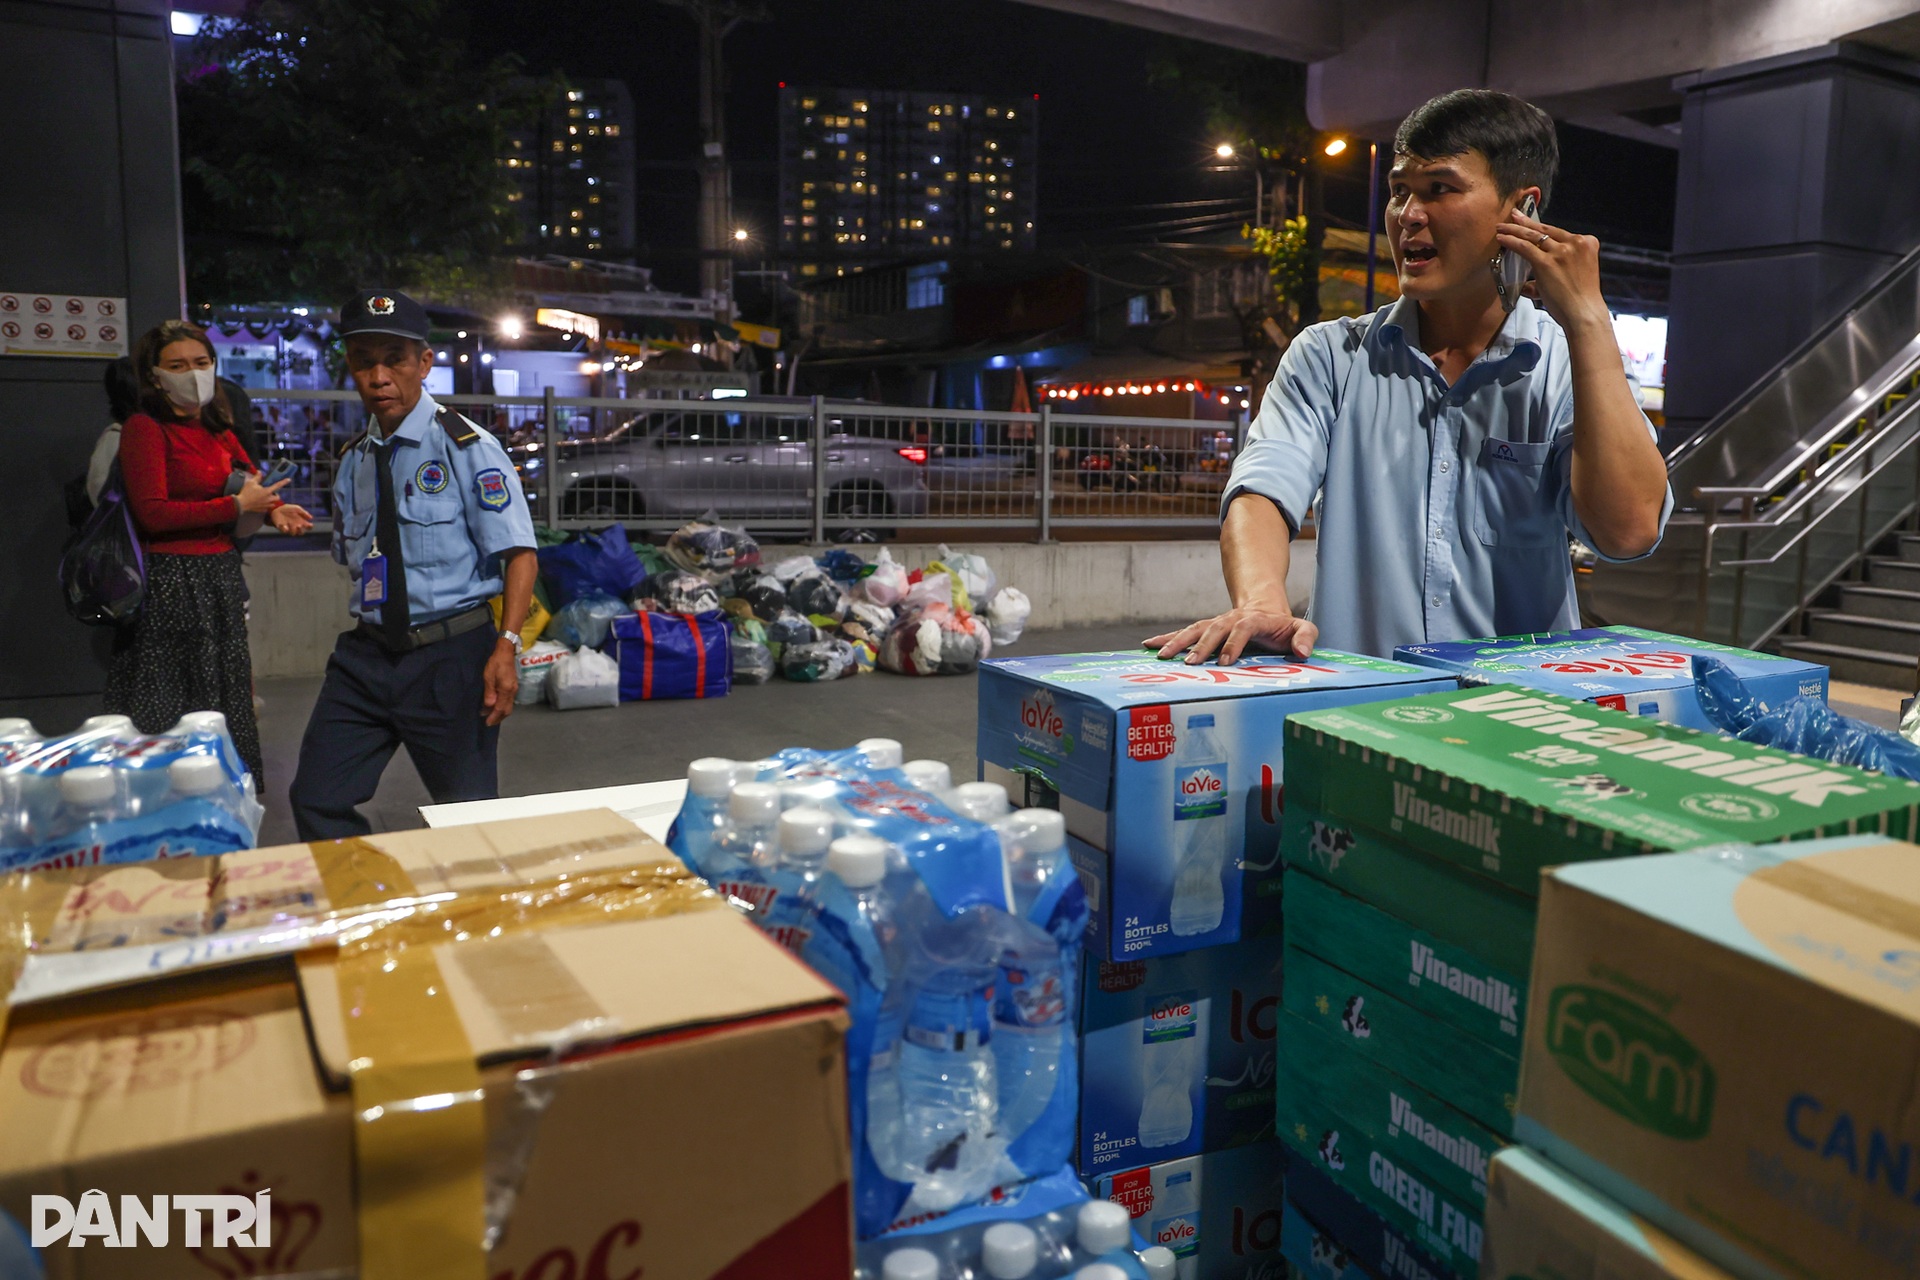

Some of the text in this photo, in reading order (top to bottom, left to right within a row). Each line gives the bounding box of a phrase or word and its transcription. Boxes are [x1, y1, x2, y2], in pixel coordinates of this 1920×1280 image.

[1021, 700, 1064, 738] laVie
[1142, 714, 1158, 723] FOR
[1128, 724, 1174, 741] BETTER
[1128, 741, 1174, 758] HEALTH
[1449, 691, 1867, 807] Vinamilk
[1182, 775, 1221, 794] laVie
[1393, 781, 1501, 856] Vinamilk
[1125, 916, 1139, 928] 24
[1125, 923, 1168, 939] BOTTLES
[1099, 974, 1145, 989] HEALTH
[1411, 940, 1517, 1022] Vinamilk
[1151, 1003, 1190, 1021] laVie
[1093, 1131, 1107, 1142] 24
[1093, 1137, 1137, 1152] BOTTLES
[1390, 1092, 1488, 1183] Vinamilk
[1785, 1093, 1919, 1203] CAN
[1123, 1180, 1138, 1189] FOR
[1369, 1151, 1435, 1228] GREEN
[1157, 1224, 1195, 1244] laVie
